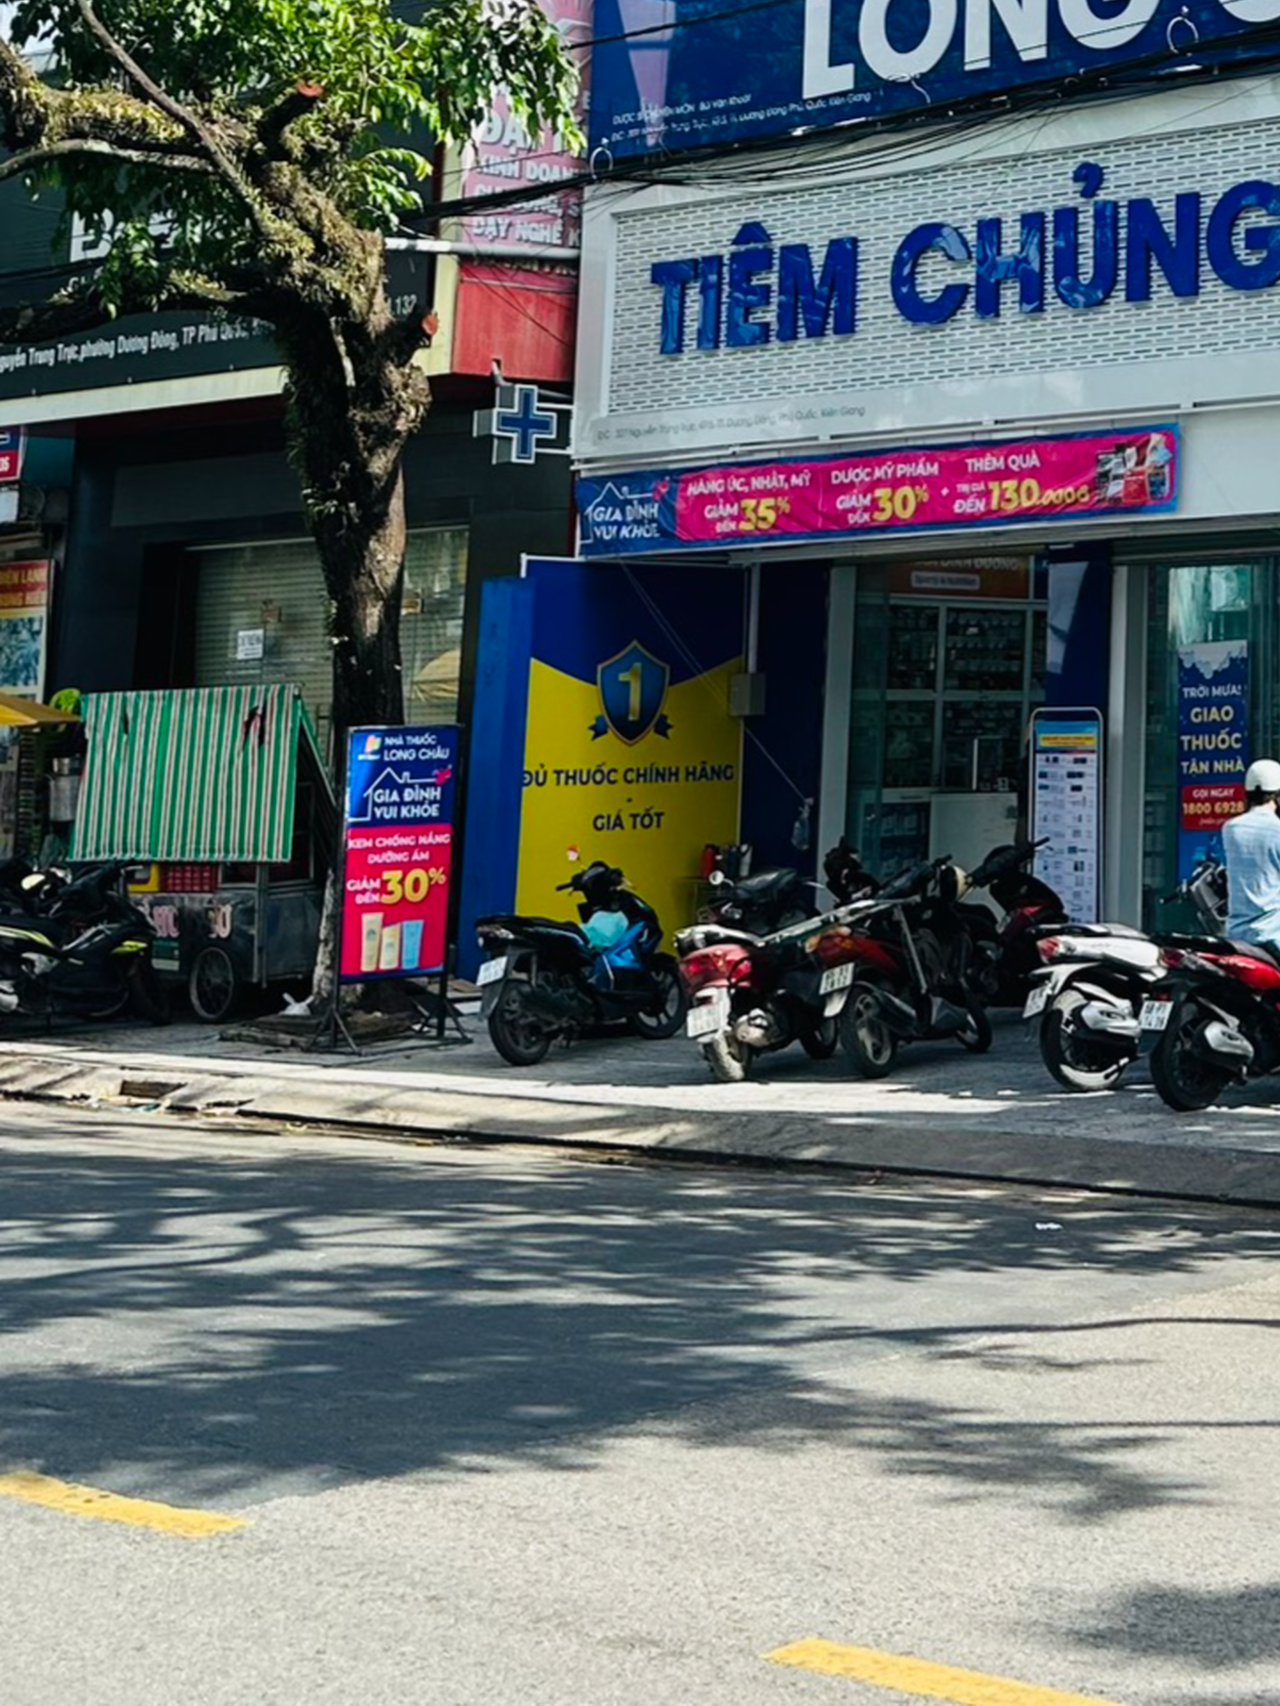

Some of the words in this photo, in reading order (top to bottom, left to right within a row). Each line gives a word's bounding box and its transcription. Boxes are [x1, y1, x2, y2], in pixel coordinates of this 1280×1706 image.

[652, 221, 860, 355] TIÊM
[966, 454, 1005, 474] THÊM
[1008, 449, 1041, 472] QUÀ
[593, 505, 623, 523] GIA
[1190, 704, 1234, 723] GIAO
[1180, 727, 1243, 751] THUỐC
[383, 749, 417, 762] LONG
[418, 746, 450, 761] CHÂU
[553, 762, 618, 786] THUỐC
[623, 762, 680, 785] CHÍNH
[684, 760, 735, 782] HÃNG
[1181, 758, 1210, 777] TẬN
[1213, 755, 1246, 774] NHÀ
[374, 788, 400, 803] GIA
[402, 784, 441, 803] ĐÌNH
[374, 806, 399, 819] VUI
[400, 798, 440, 818] KHỎE
[592, 808, 625, 832] GIÁ
[629, 805, 665, 830] TỐT
